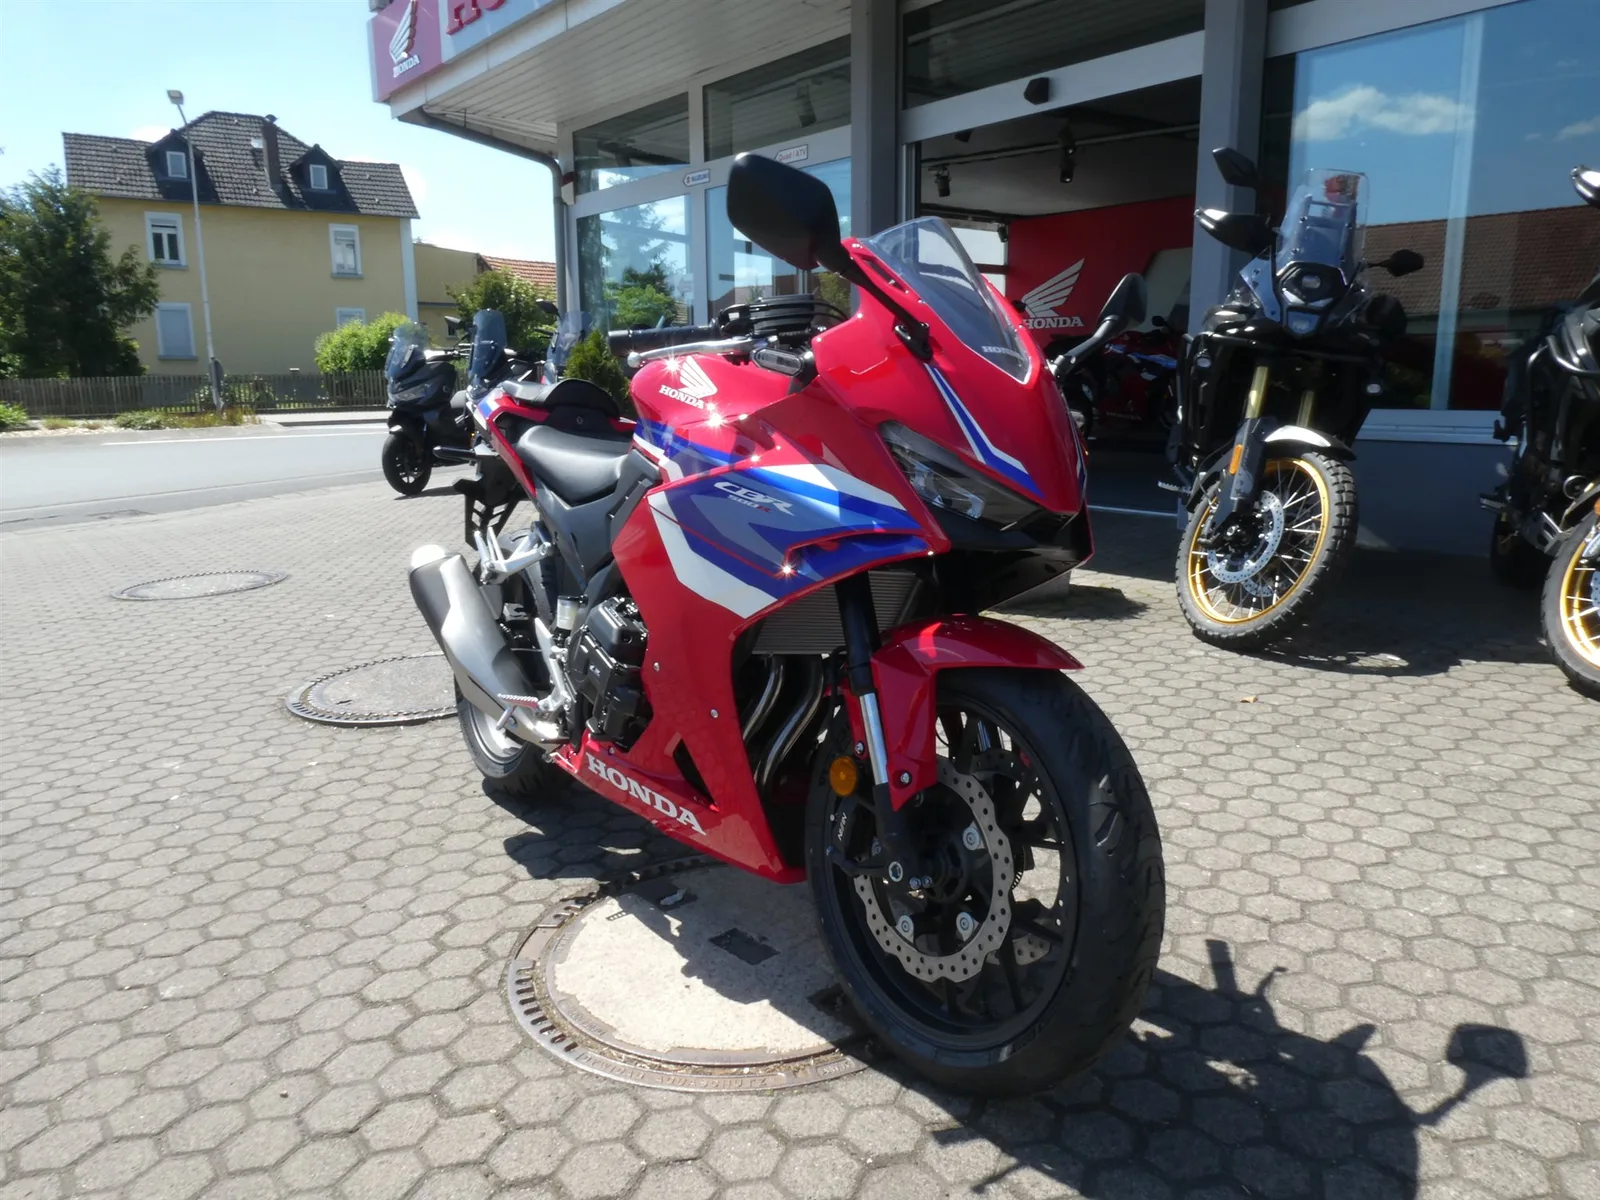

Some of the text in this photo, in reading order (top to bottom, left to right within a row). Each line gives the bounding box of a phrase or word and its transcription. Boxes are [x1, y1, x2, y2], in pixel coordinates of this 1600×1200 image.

[393, 54, 421, 78] HONDA
[1022, 316, 1085, 330] HONDA
[659, 384, 705, 410] HONDA
[714, 481, 795, 517] CBR
[727, 494, 772, 513] 500R
[586, 752, 707, 836] HONDA
